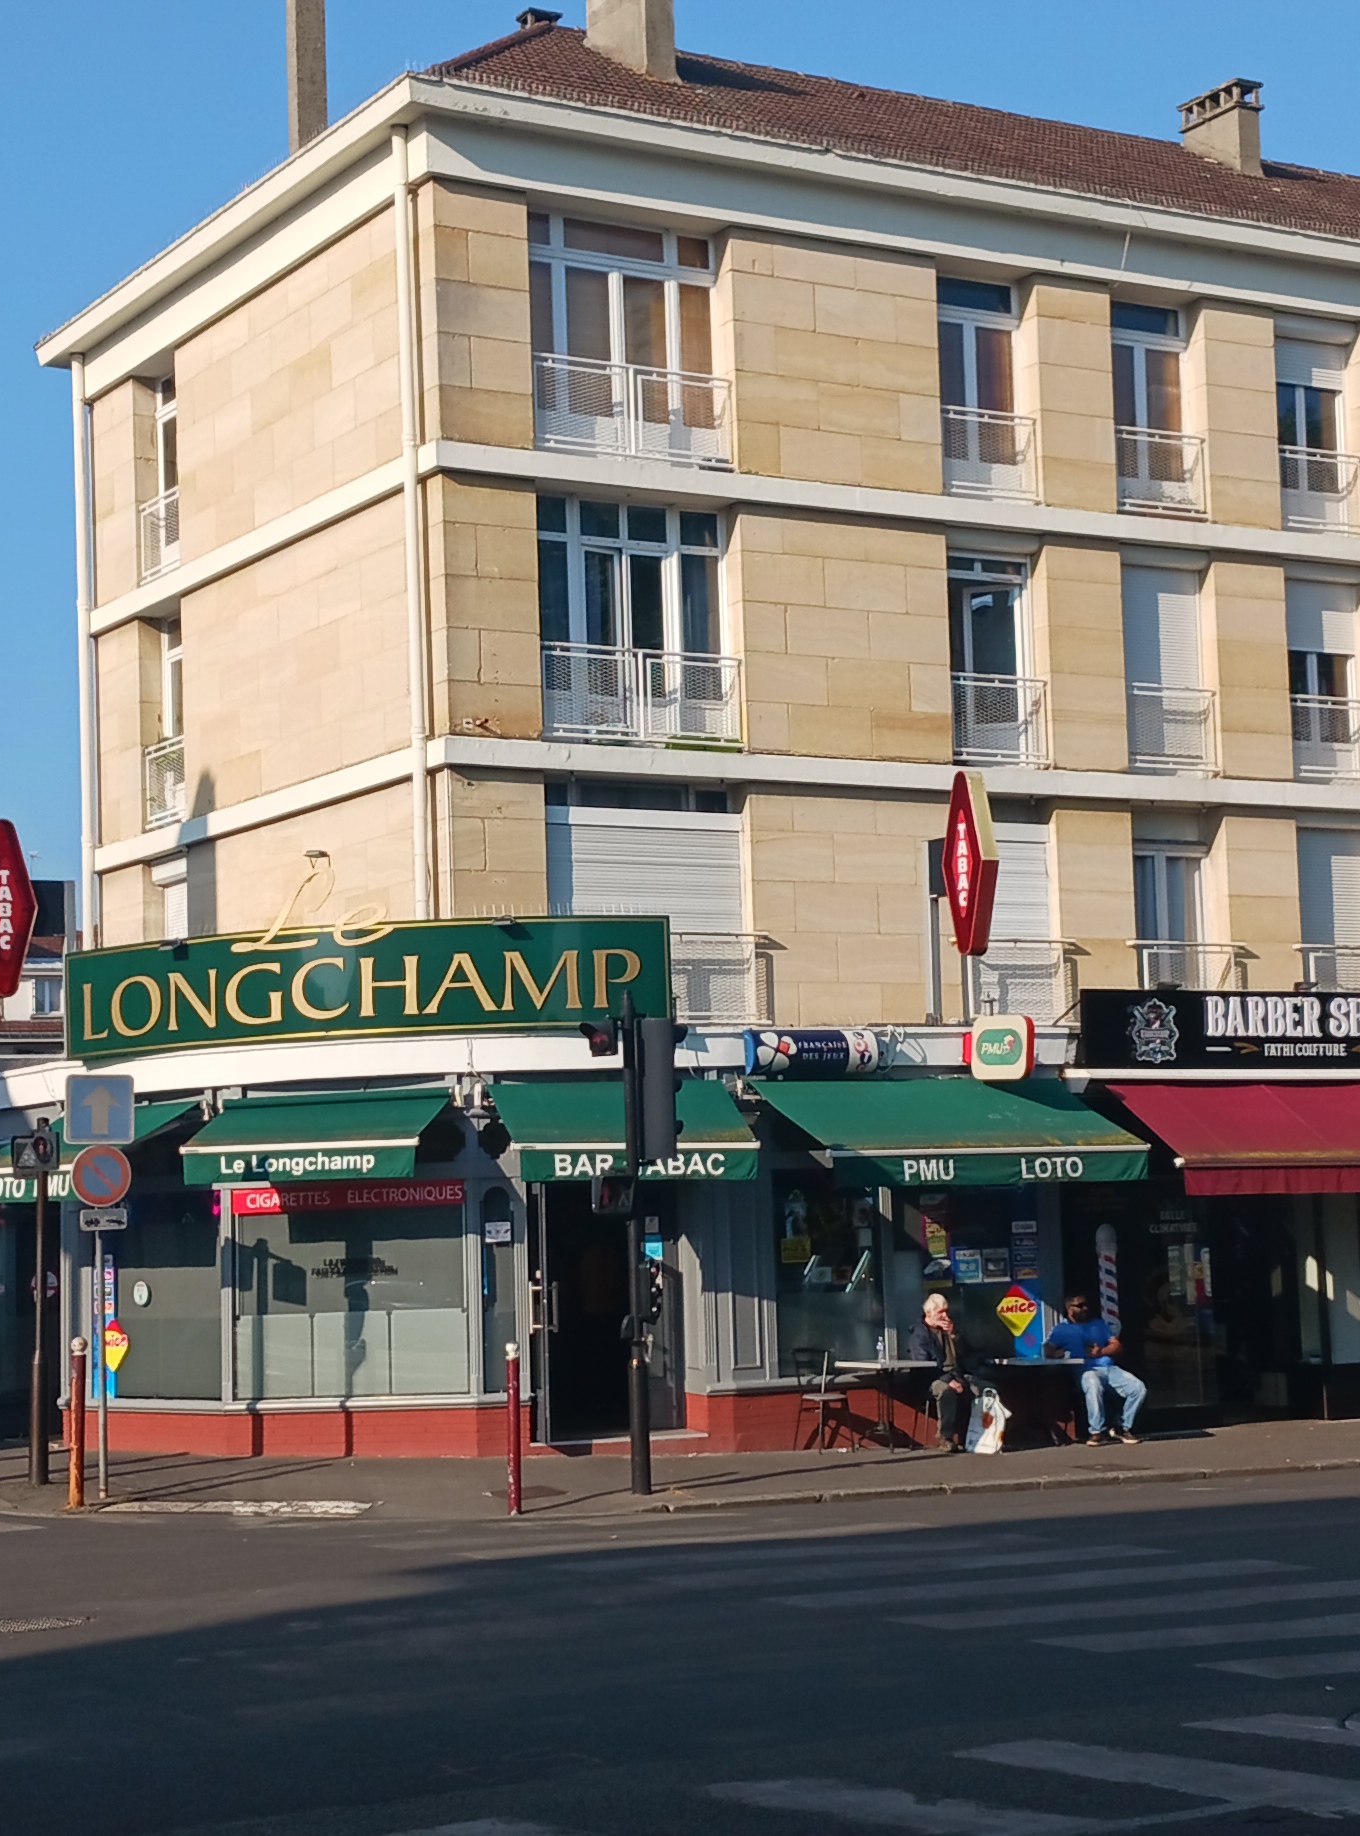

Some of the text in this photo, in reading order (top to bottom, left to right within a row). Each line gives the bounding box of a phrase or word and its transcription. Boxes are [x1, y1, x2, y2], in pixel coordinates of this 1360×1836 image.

[956, 822, 969, 907] TABAC
[230, 857, 396, 953] Le
[82, 947, 641, 1041] LONGCHAMP
[1204, 996, 1323, 1038] BARBER
[802, 1052, 844, 1061] DES JEUX
[980, 1042, 1003, 1055] PMU
[1296, 1043, 1348, 1056] COIFFURE
[220, 1152, 375, 1176] Le Longchamp
[554, 1153, 725, 1177] BAR ABAC
[903, 1156, 1083, 1181] PMU LOTO
[246, 1185, 463, 1209] CIGARETTES ELECTRONIQUES
[997, 1301, 1037, 1314] AMIGO
